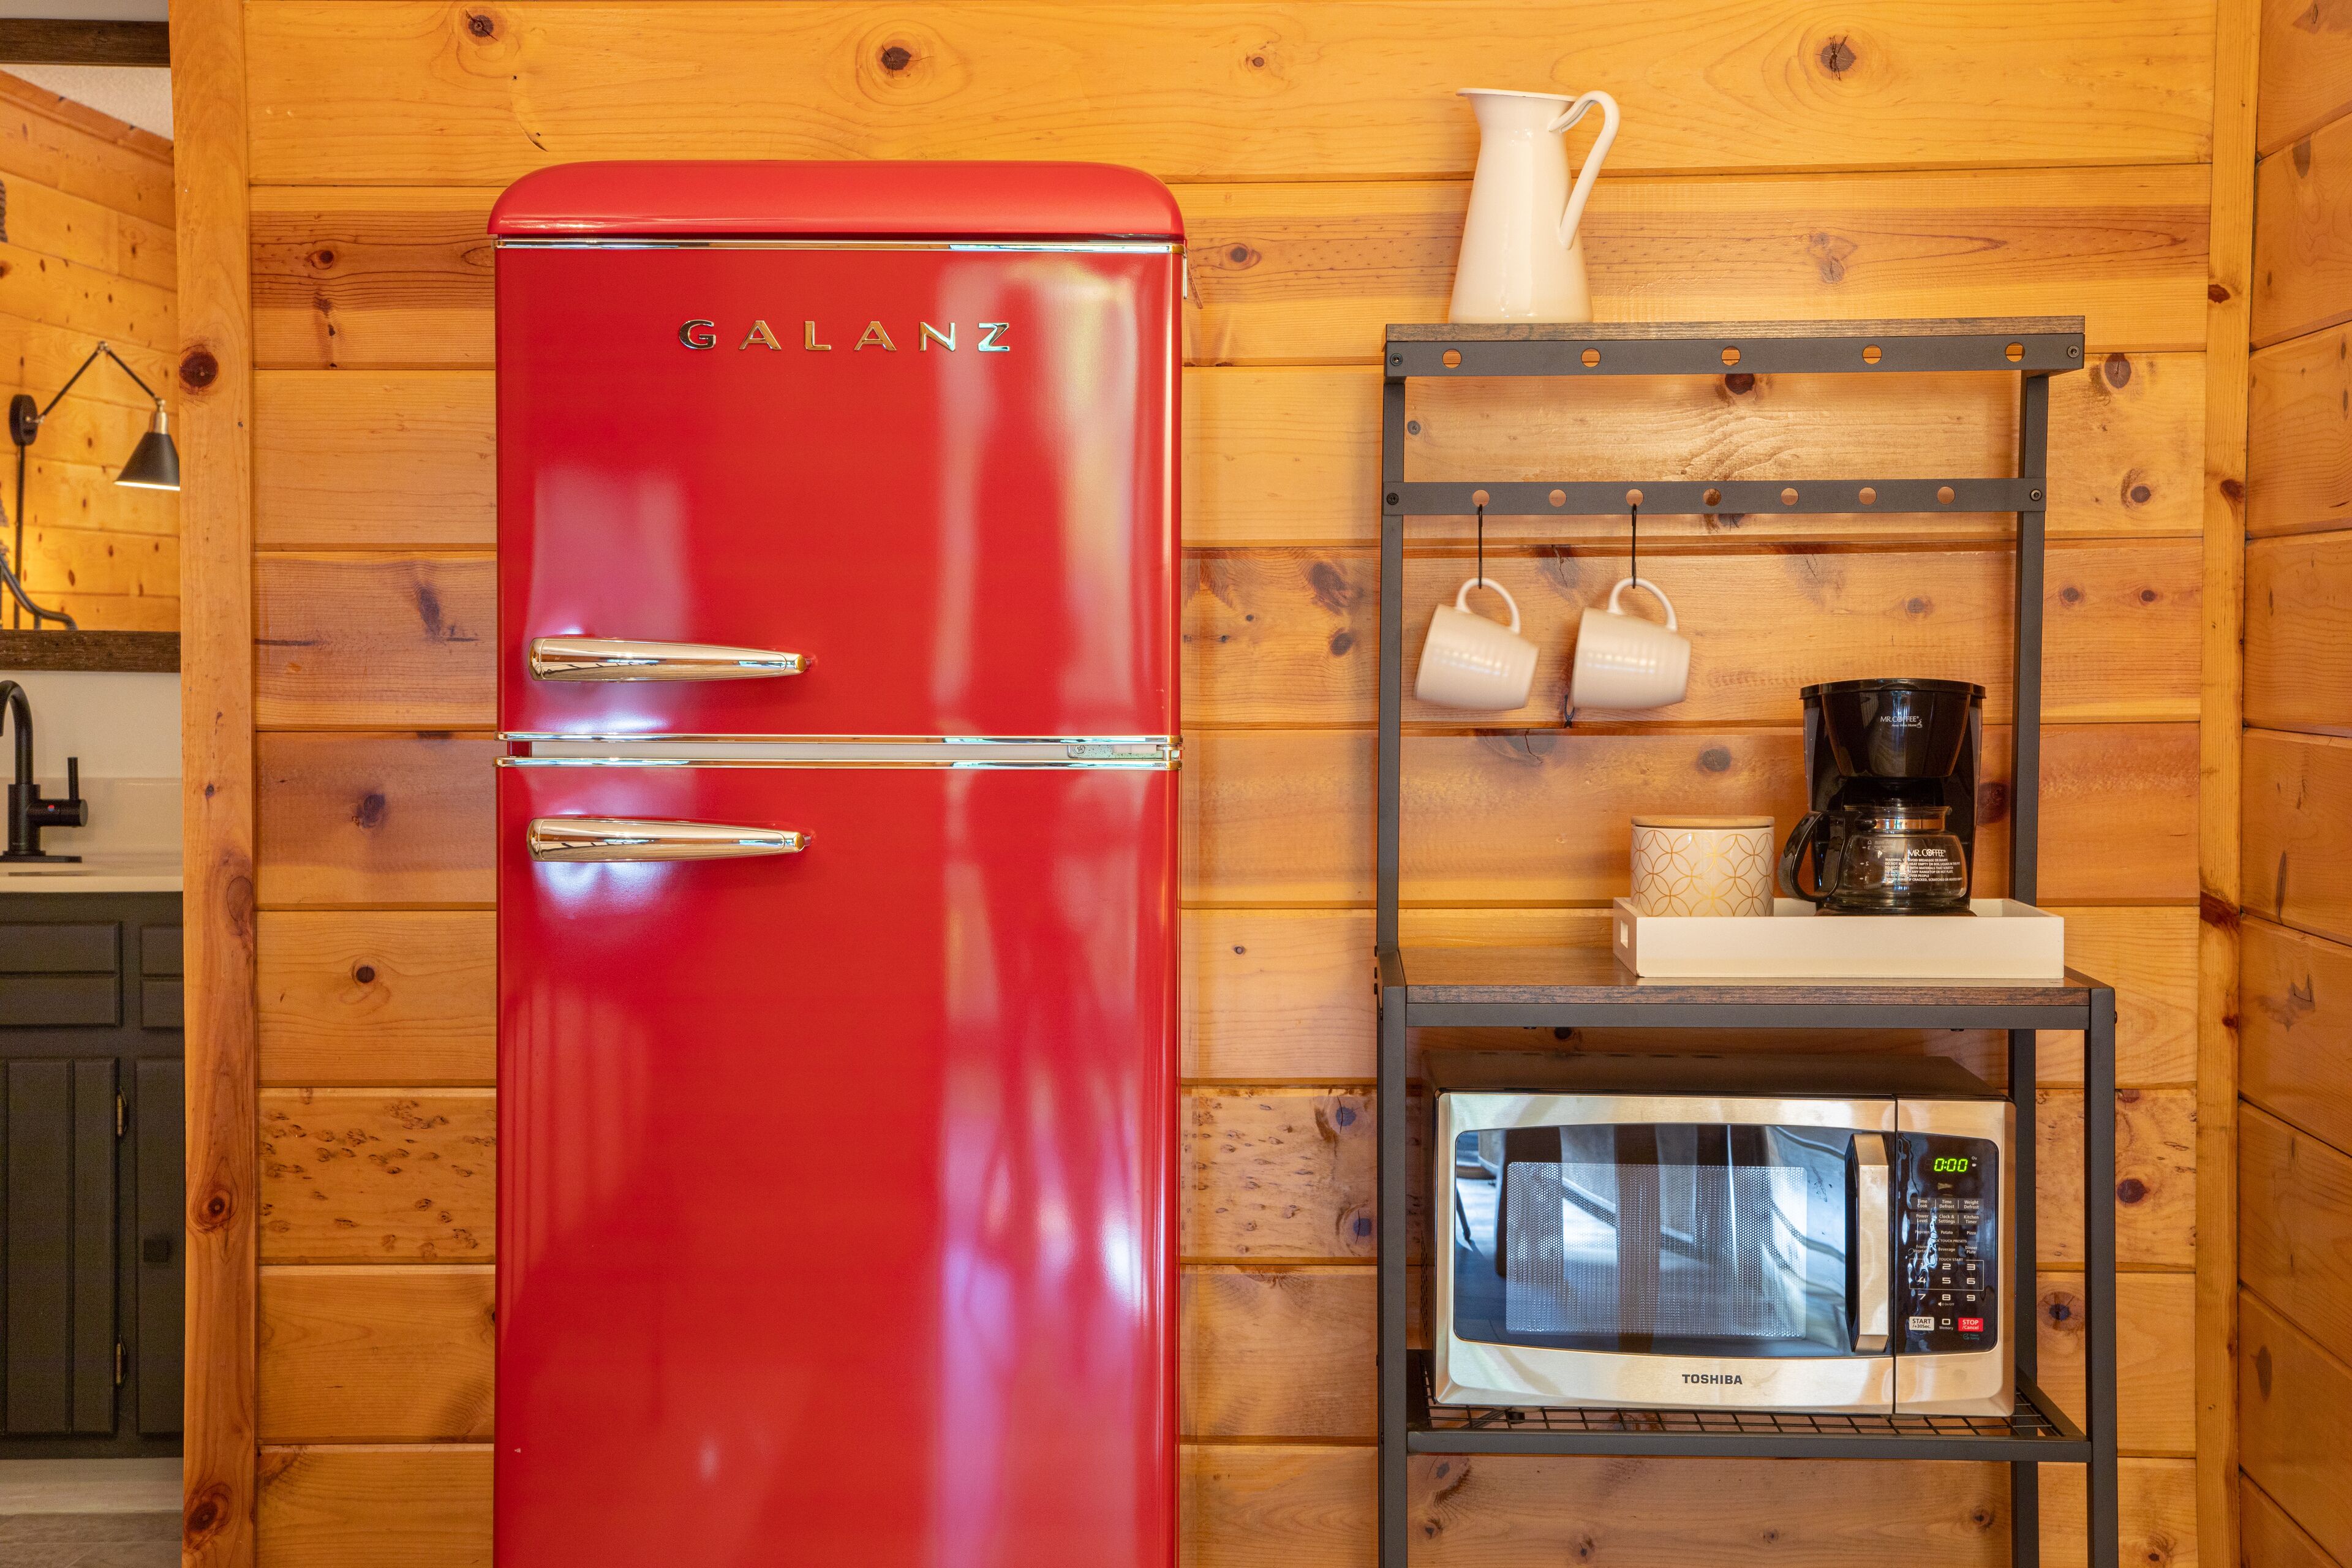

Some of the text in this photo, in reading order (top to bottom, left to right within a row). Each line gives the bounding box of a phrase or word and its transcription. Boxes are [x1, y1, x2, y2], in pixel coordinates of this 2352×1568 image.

[678, 319, 1010, 352] GALANZ
[1921, 848, 1945, 857] COFFEE
[1934, 1158, 1968, 1172] 0:00
[1682, 1374, 1743, 1384] TOSHIBA
